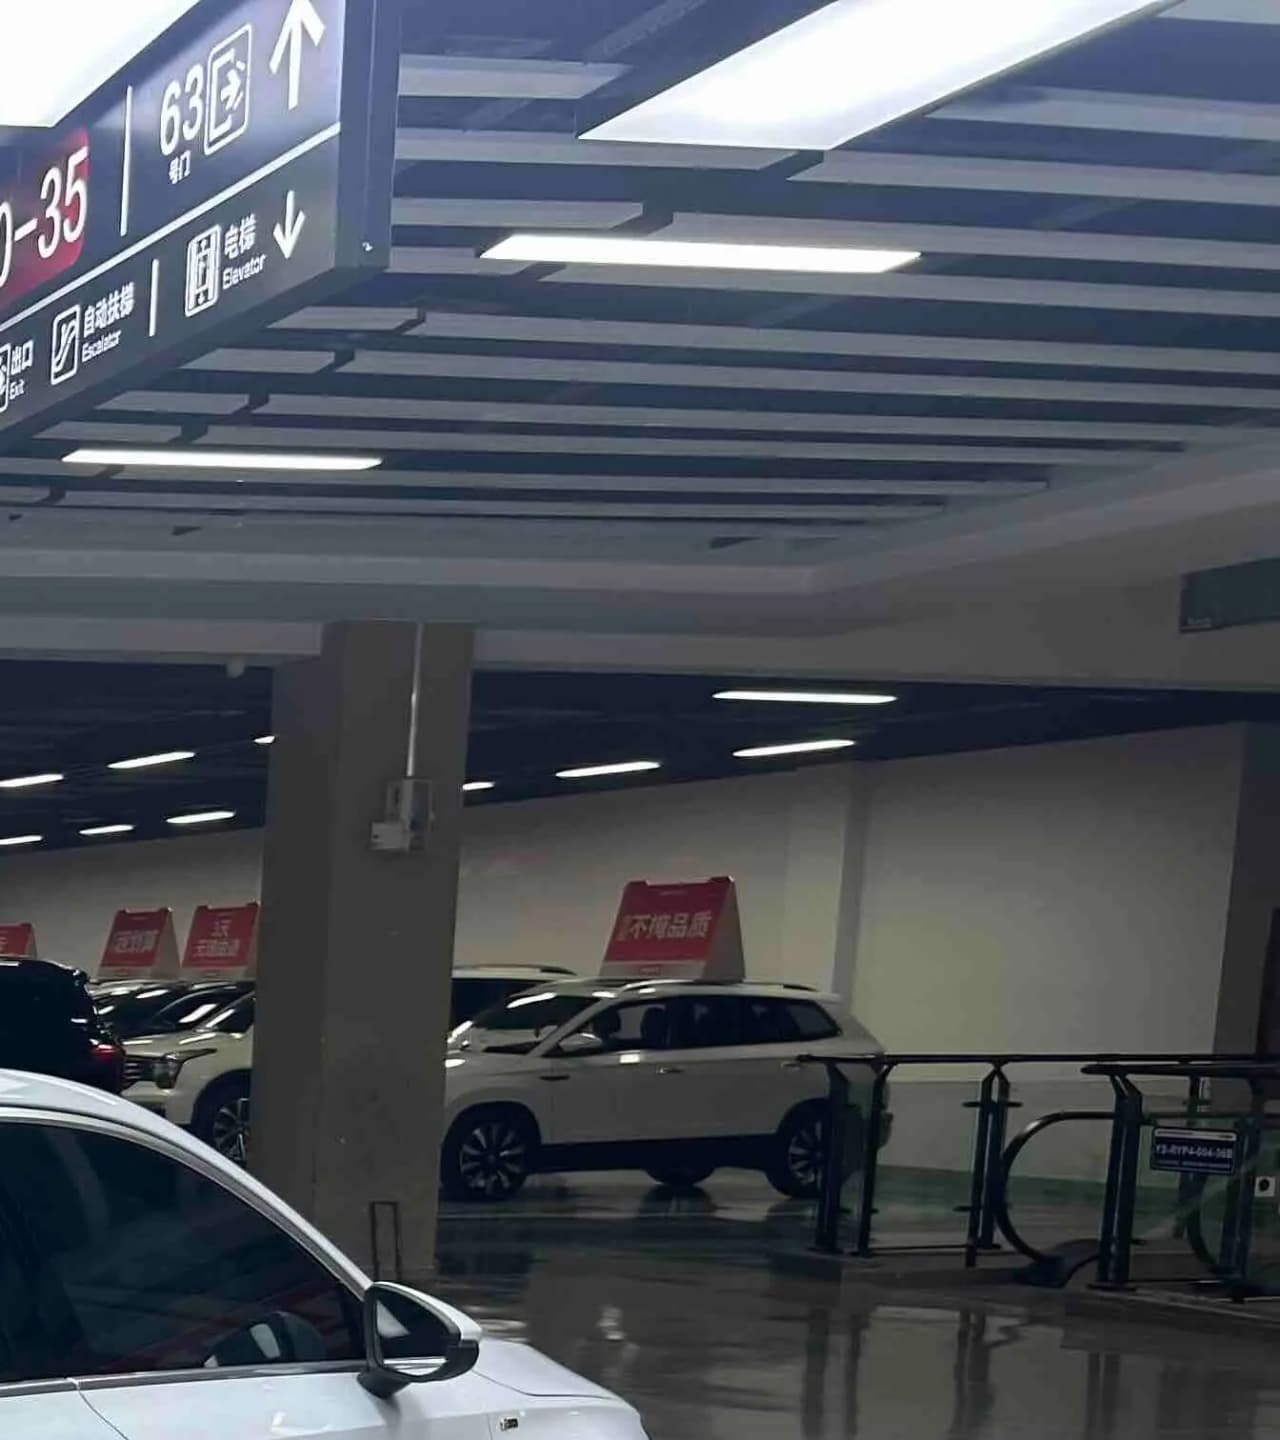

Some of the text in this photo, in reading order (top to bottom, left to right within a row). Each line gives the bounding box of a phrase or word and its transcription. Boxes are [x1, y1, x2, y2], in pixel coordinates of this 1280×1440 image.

[160, 63, 204, 156] 63
[224, 212, 257, 260] 电梯
[222, 253, 267, 290] Elevator
[83, 281, 135, 338] 自动扶梯
[11, 340, 34, 376] 出口
[81, 329, 122, 363] Escalator
[9, 379, 25, 400] Exit
